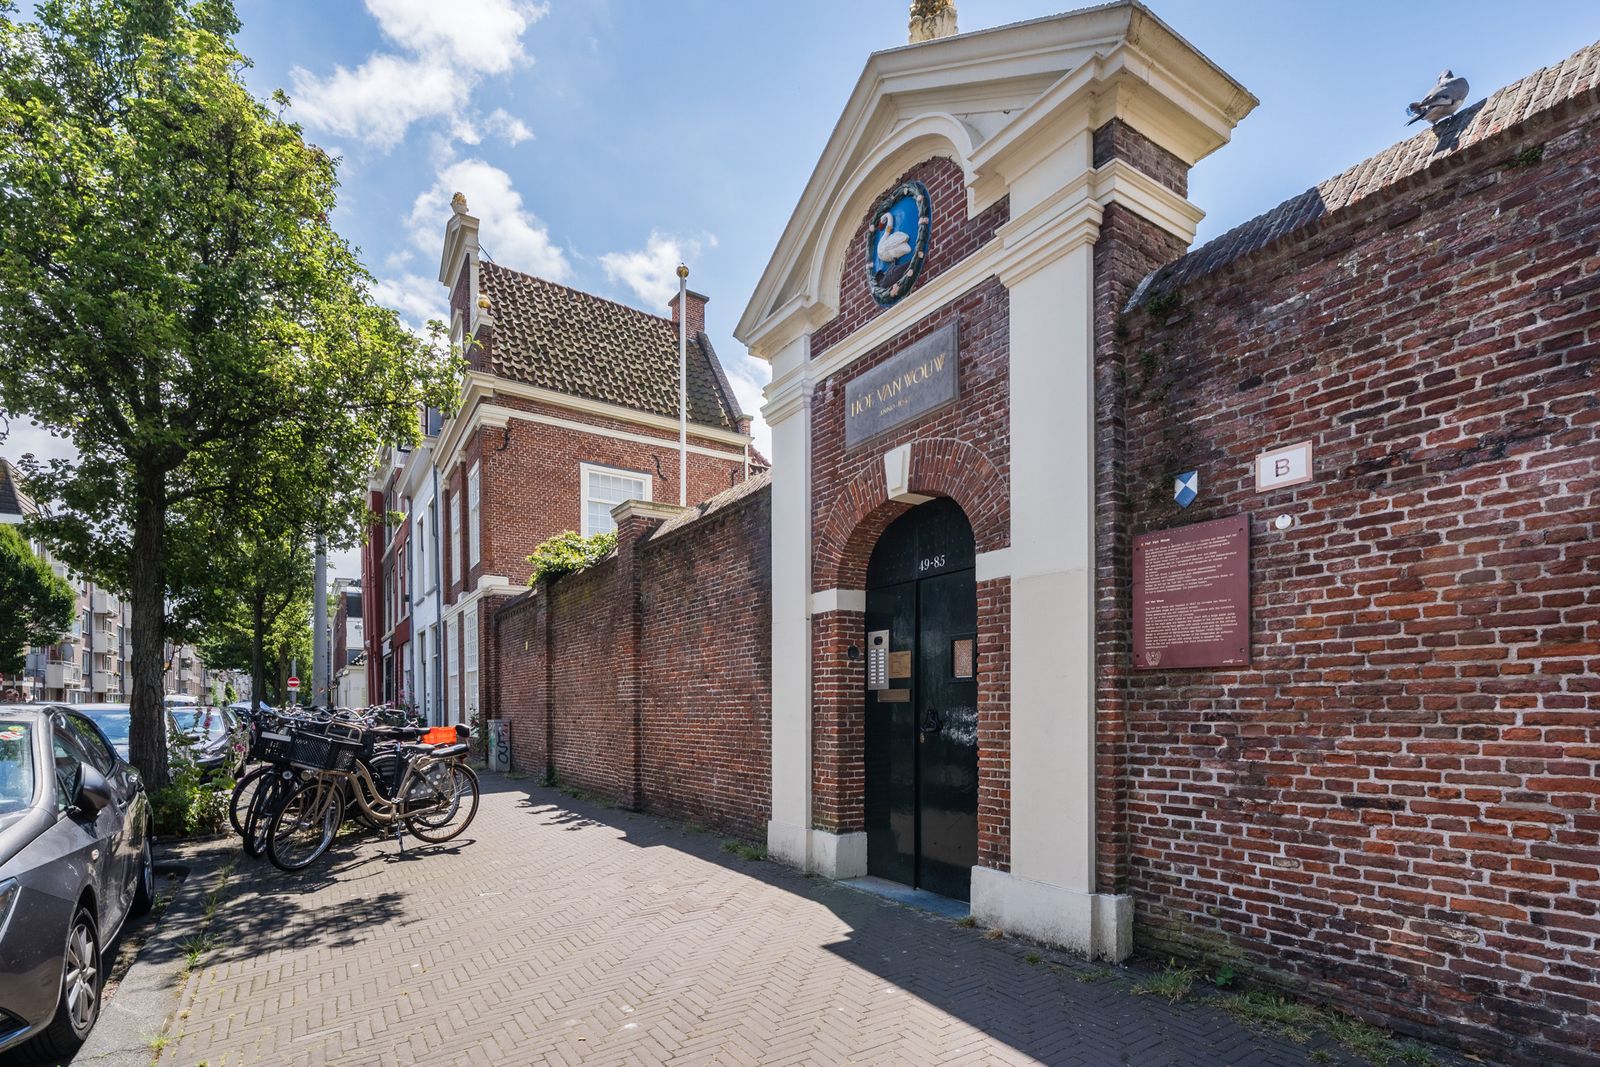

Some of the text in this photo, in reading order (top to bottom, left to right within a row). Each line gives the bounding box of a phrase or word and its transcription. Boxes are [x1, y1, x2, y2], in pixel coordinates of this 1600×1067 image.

[877, 378, 902, 401] VAN
[904, 352, 945, 387] WOUW
[1275, 458, 1291, 478] B
[918, 554, 946, 571] 49-85
